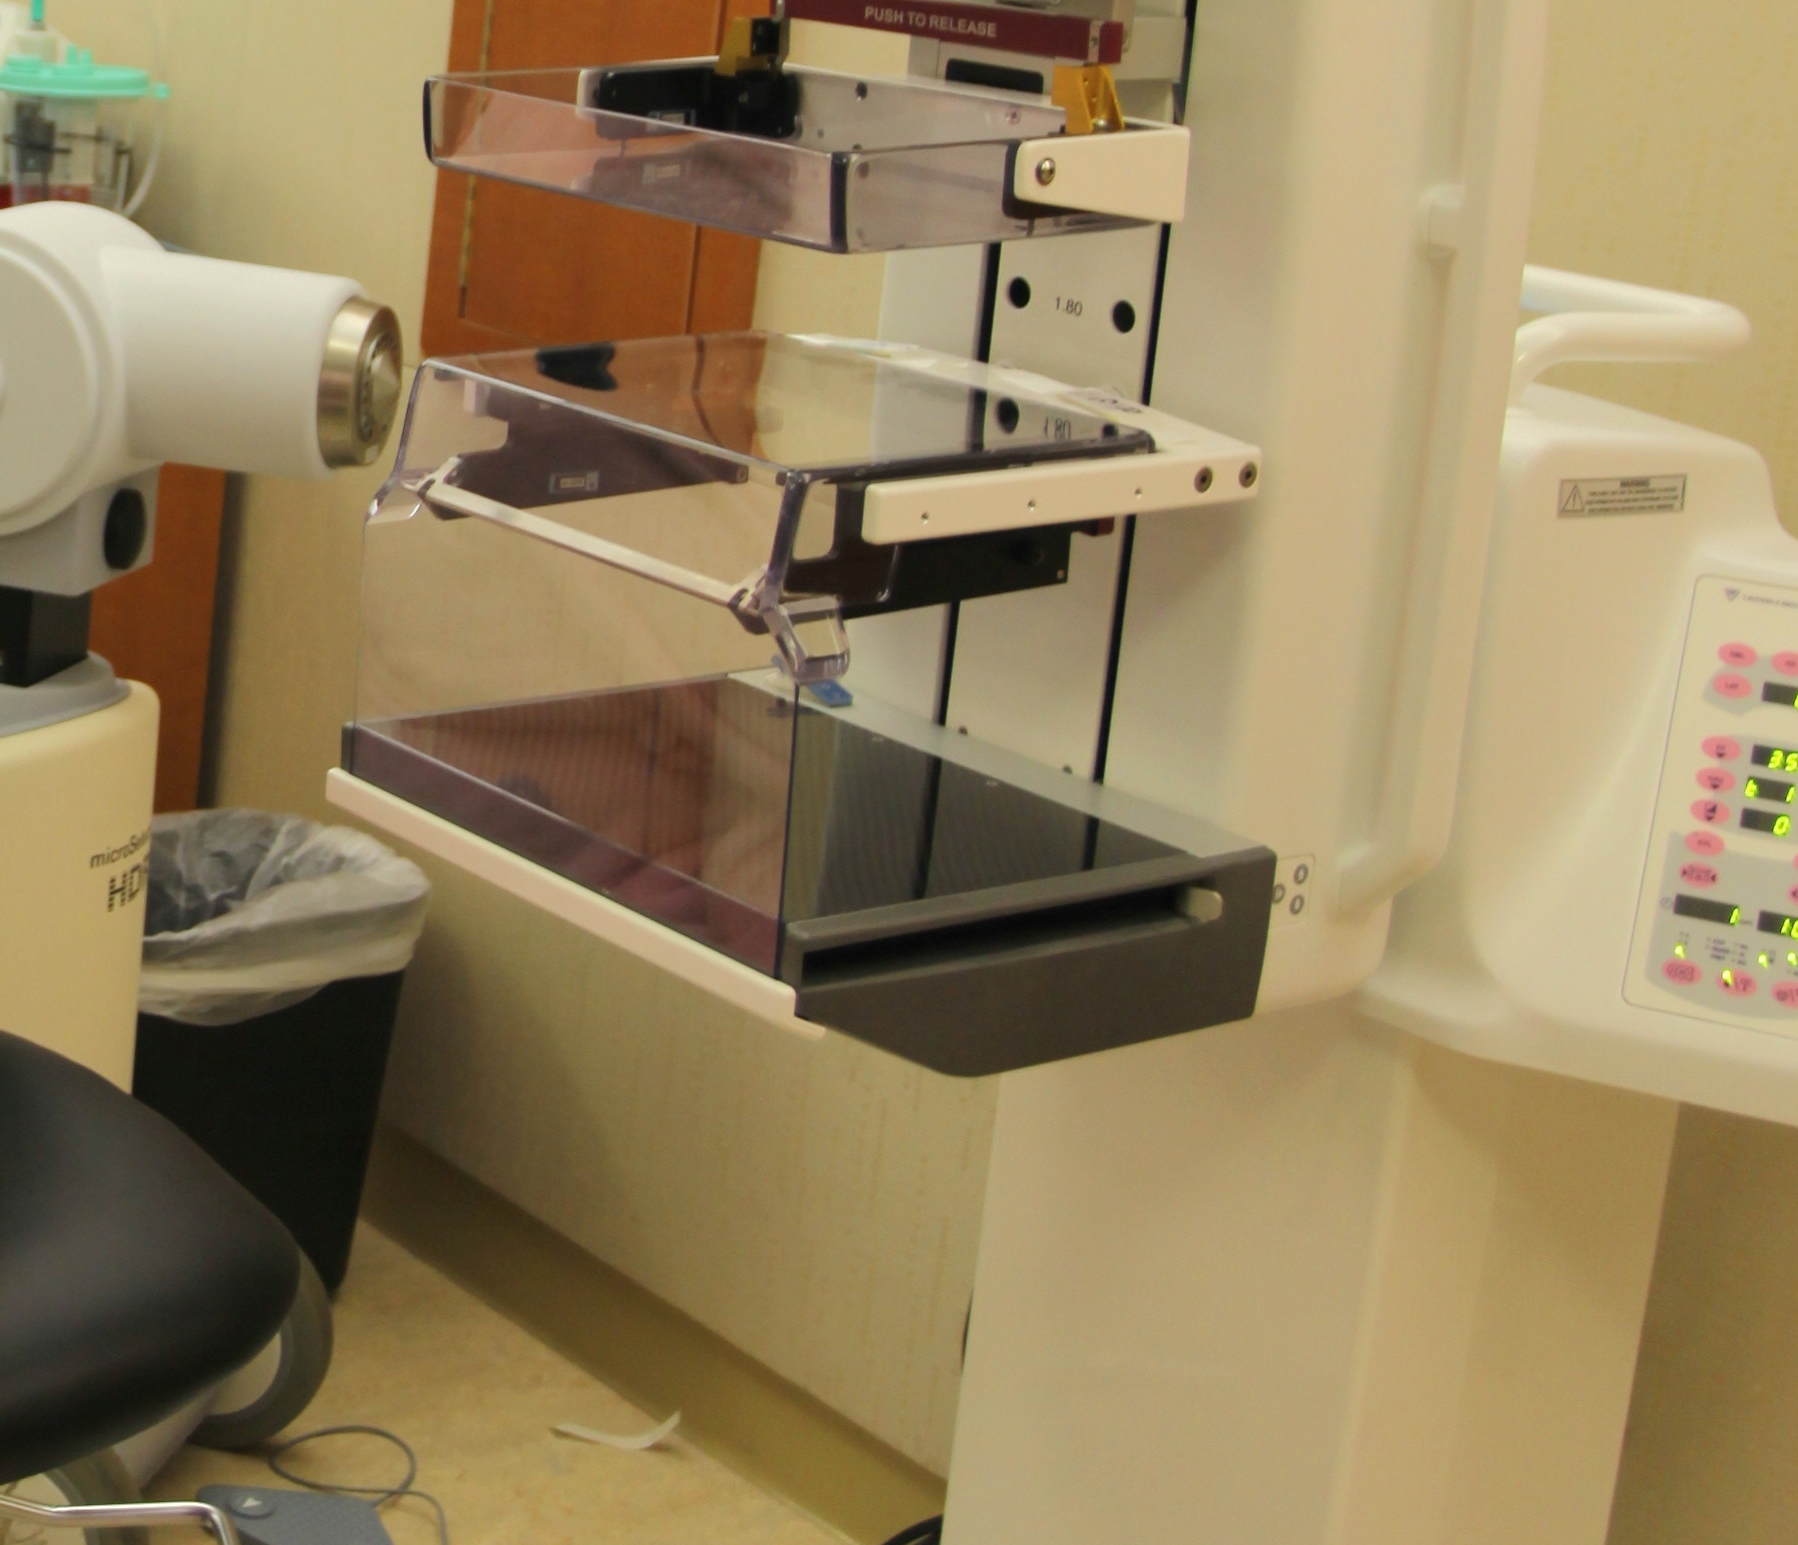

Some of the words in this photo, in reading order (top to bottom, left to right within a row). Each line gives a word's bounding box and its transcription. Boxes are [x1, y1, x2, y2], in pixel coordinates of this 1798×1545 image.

[864, 5, 904, 24] PUSH
[907, 11, 927, 27] TO
[929, 14, 998, 38] RELEASE
[1056, 296, 1083, 317] 1.80
[1771, 813, 1791, 837] 0
